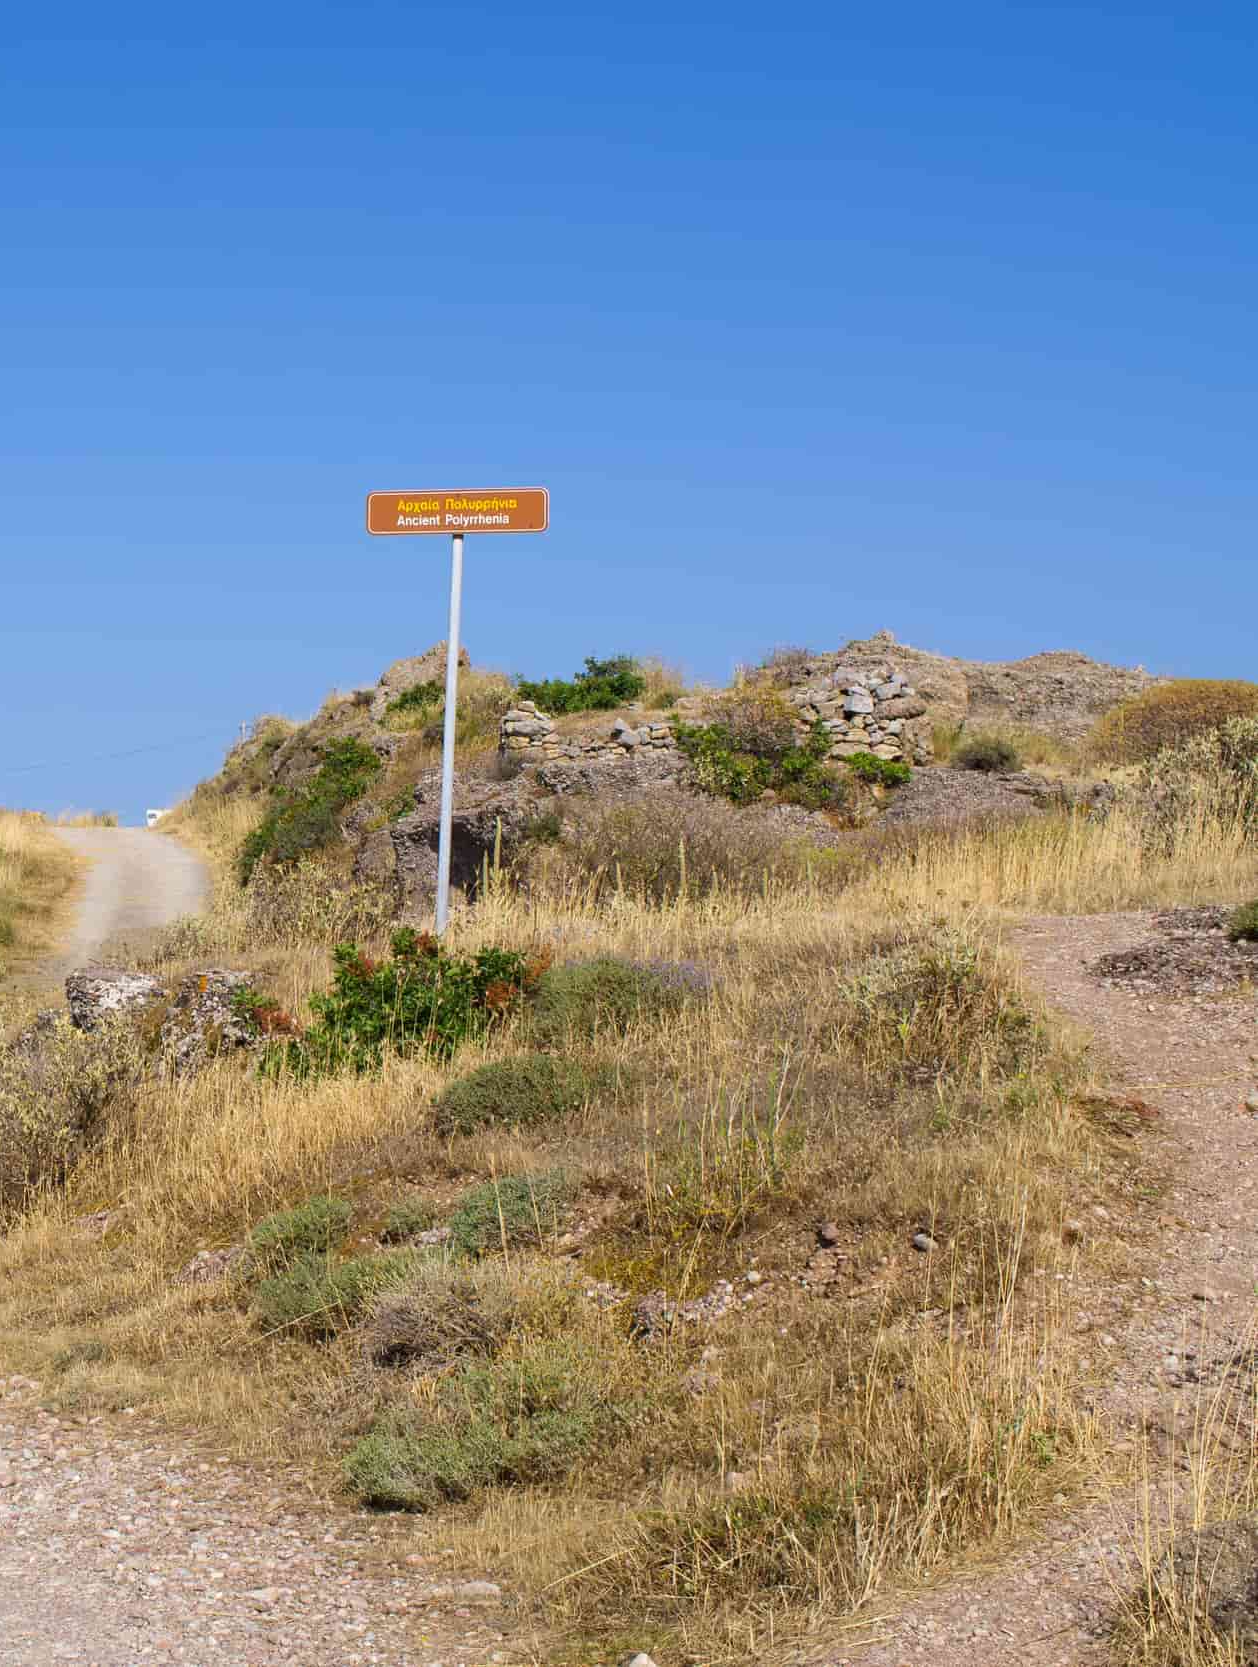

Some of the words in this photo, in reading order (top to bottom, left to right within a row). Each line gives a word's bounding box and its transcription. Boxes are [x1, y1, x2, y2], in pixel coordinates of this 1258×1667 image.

[397, 498, 440, 513] Αρχαία
[397, 514, 440, 527] Ancient
[445, 513, 510, 528] Polyrrhenia
